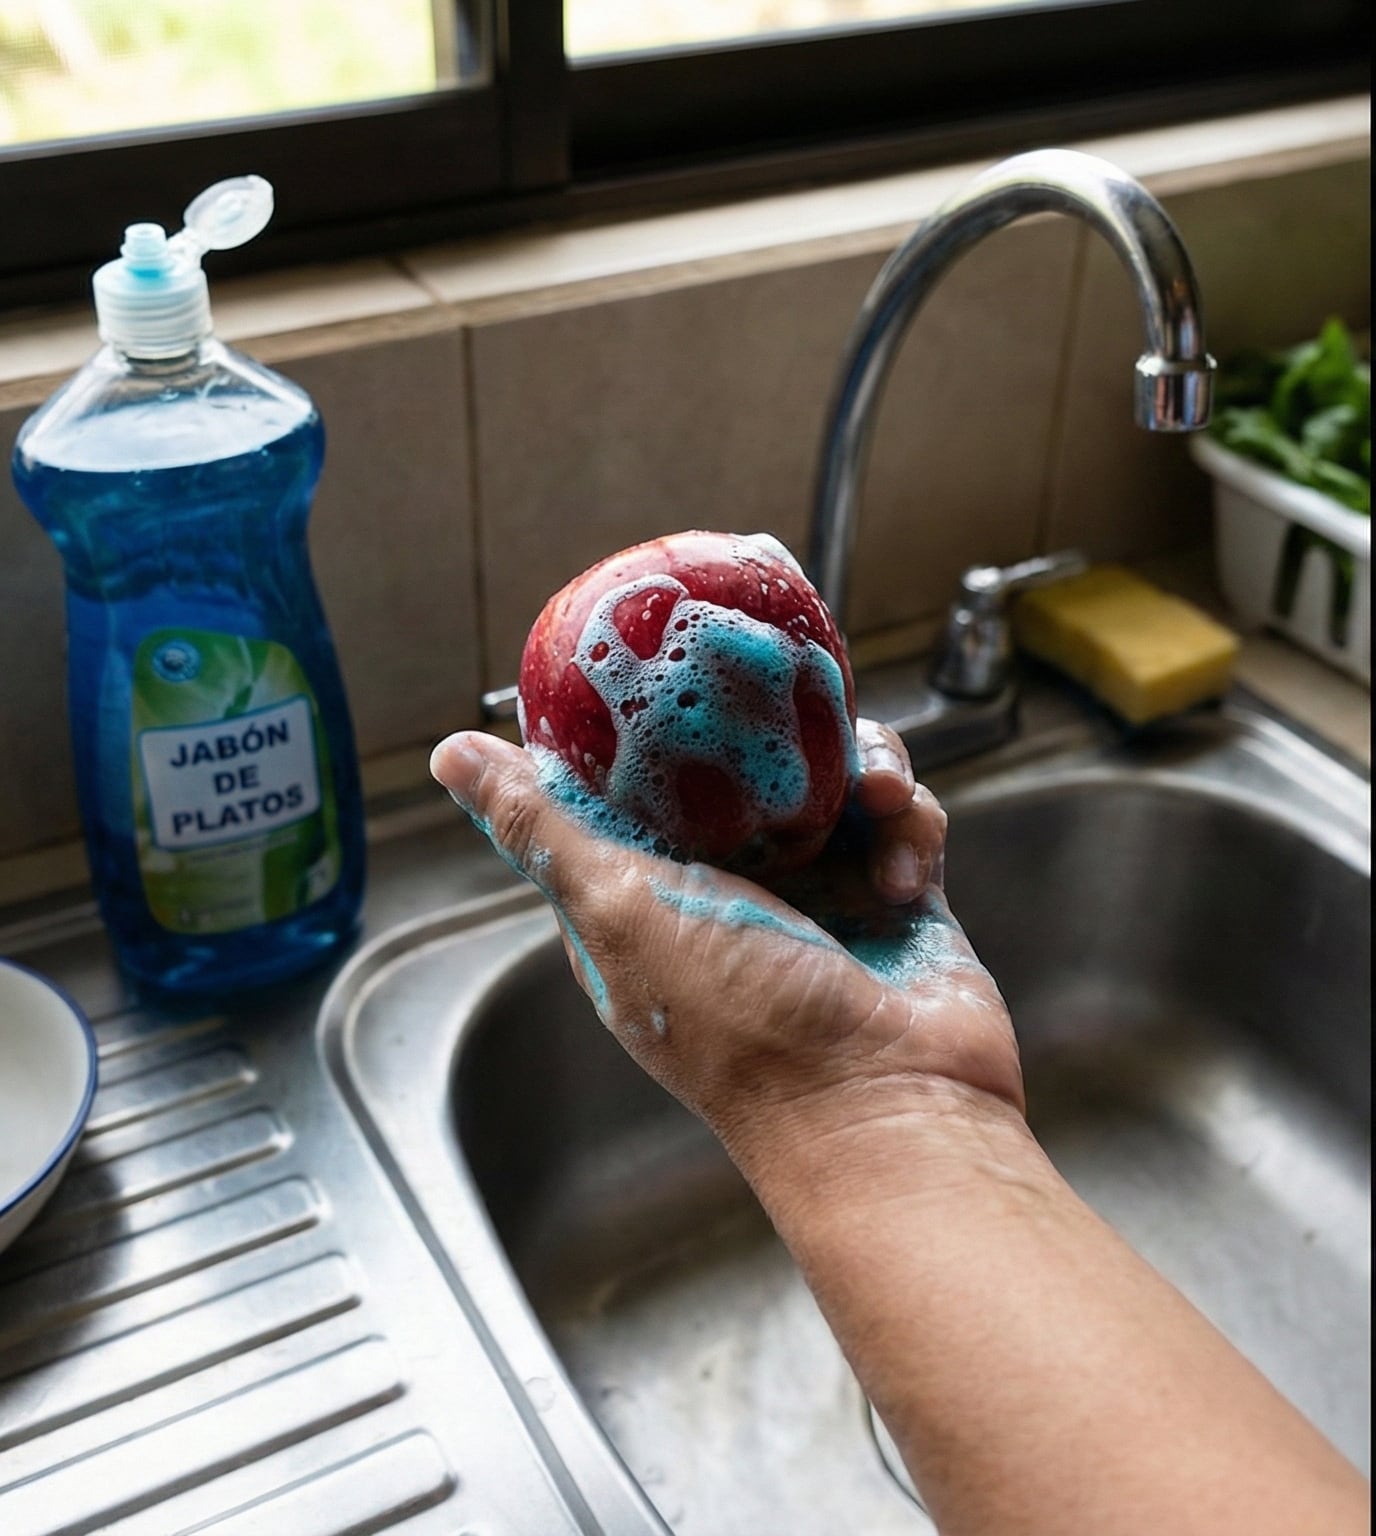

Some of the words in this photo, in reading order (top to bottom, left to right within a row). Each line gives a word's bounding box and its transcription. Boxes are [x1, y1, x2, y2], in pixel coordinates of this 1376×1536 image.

[169, 717, 289, 768] JABÓN
[213, 765, 260, 795] DE
[172, 785, 304, 836] PLATOS
